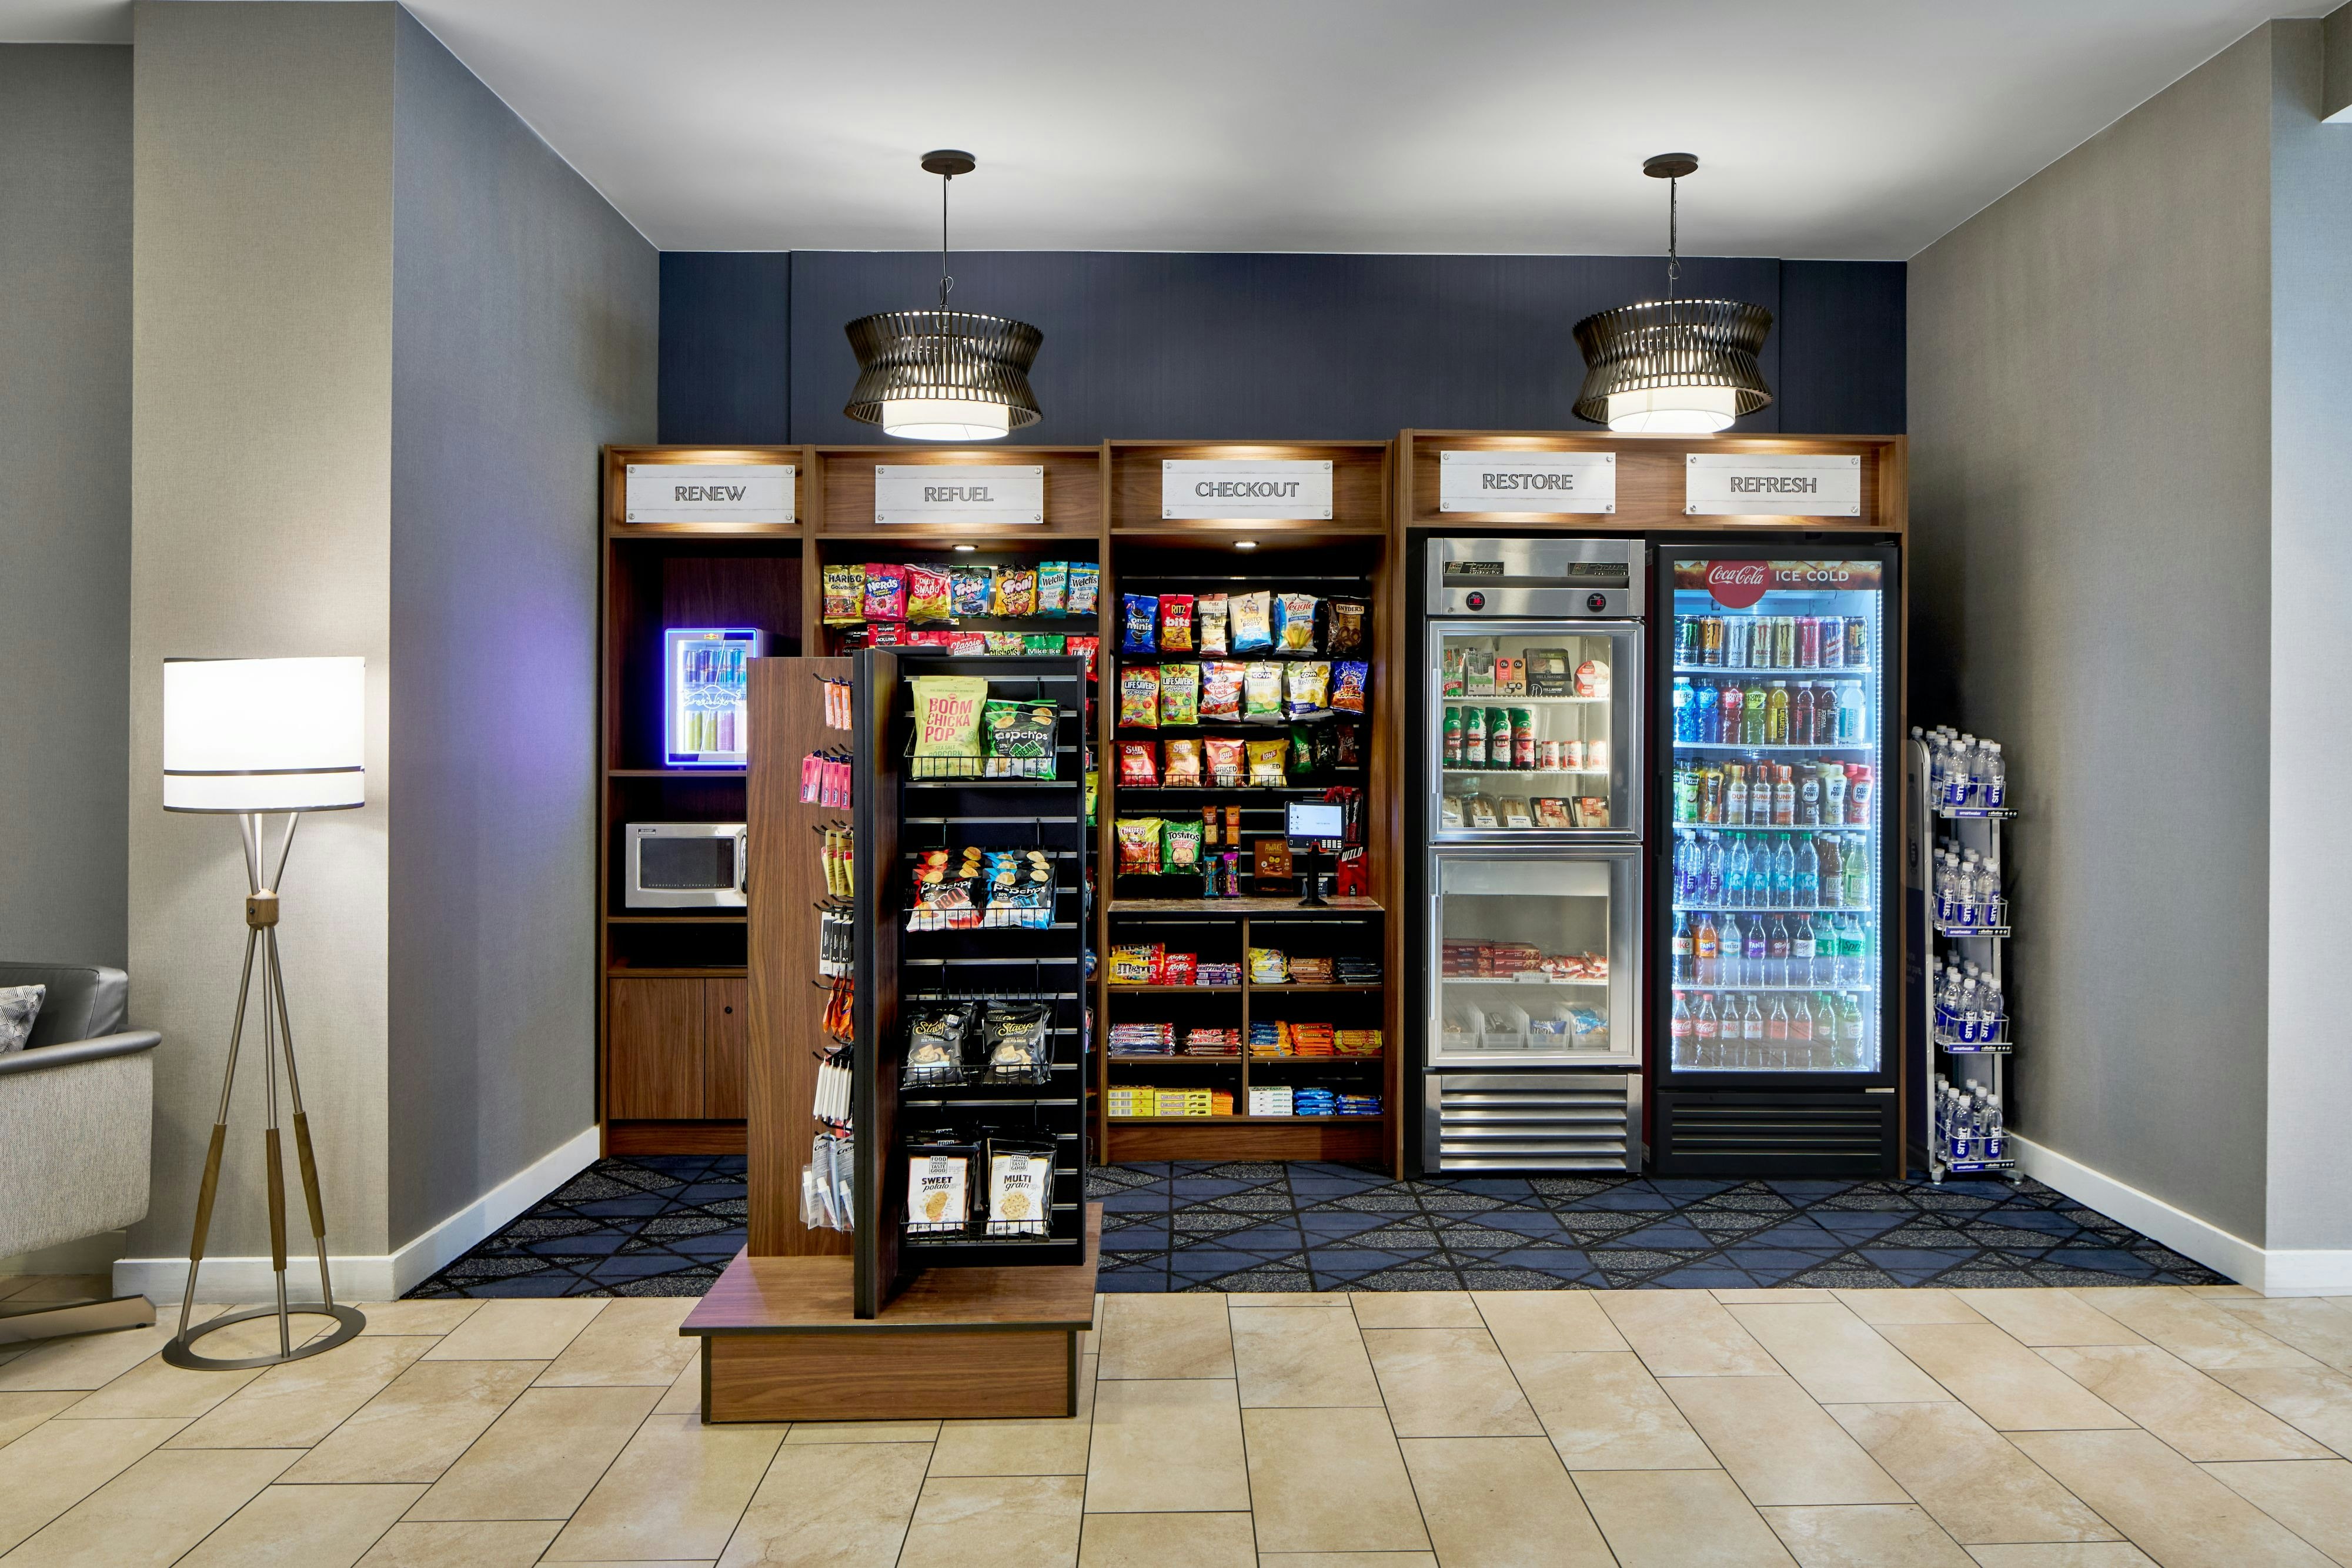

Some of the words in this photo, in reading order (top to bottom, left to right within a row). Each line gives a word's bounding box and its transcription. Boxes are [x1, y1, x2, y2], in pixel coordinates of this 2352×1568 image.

[1483, 474, 1573, 490] RESTORE
[1731, 477, 1817, 493] REFRESH
[674, 486, 747, 502] RENEW
[924, 486, 994, 502] REFUEL
[1195, 482, 1299, 497] CHECKOUT
[828, 574, 862, 583] HARIBO
[1043, 574, 1064, 587] Welch's
[1072, 575, 1098, 587] Welch's
[1708, 565, 1767, 585] Coca-Cola
[1776, 571, 1801, 581] ICE
[1807, 570, 1849, 581] COLD
[1001, 574, 1033, 593] Trolli
[1171, 604, 1186, 614] RITZ
[1285, 601, 1314, 611] Veggie
[1127, 621, 1152, 631] minis
[1165, 616, 1190, 627] bits
[950, 640, 981, 651] Classic
[930, 698, 973, 715] BOOM
[927, 713, 970, 727] CHICKA
[925, 726, 955, 743] POP
[928, 751, 963, 759] POPCORN
[1010, 744, 1021, 755] SOUR
[1015, 742, 1038, 758] CREAM
[1125, 745, 1144, 754] Sun
[1172, 744, 1191, 753] Sun
[1220, 750, 1233, 760] Lay's
[1262, 750, 1277, 760] Lay's
[1956, 773, 1966, 801] smart
[1992, 774, 2001, 803] smart
[1265, 843, 1282, 851] AWAKE
[1341, 847, 1364, 862] WILD
[934, 890, 965, 910] BBQ
[1943, 888, 1953, 917] smart
[1963, 894, 1973, 922] smart
[1990, 894, 1999, 922] smart
[998, 1022, 1034, 1036] Stacy's
[1965, 1010, 1975, 1039] smart
[1981, 1009, 1992, 1038] smart
[814, 1142, 828, 1152] Crest
[1957, 1126, 1968, 1155] smart
[1991, 1126, 1999, 1154] smart
[921, 1176, 953, 1185] SWEET
[1004, 1175, 1031, 1184] MULTI
[923, 1183, 949, 1192] potato
[1005, 1183, 1030, 1191] grain
